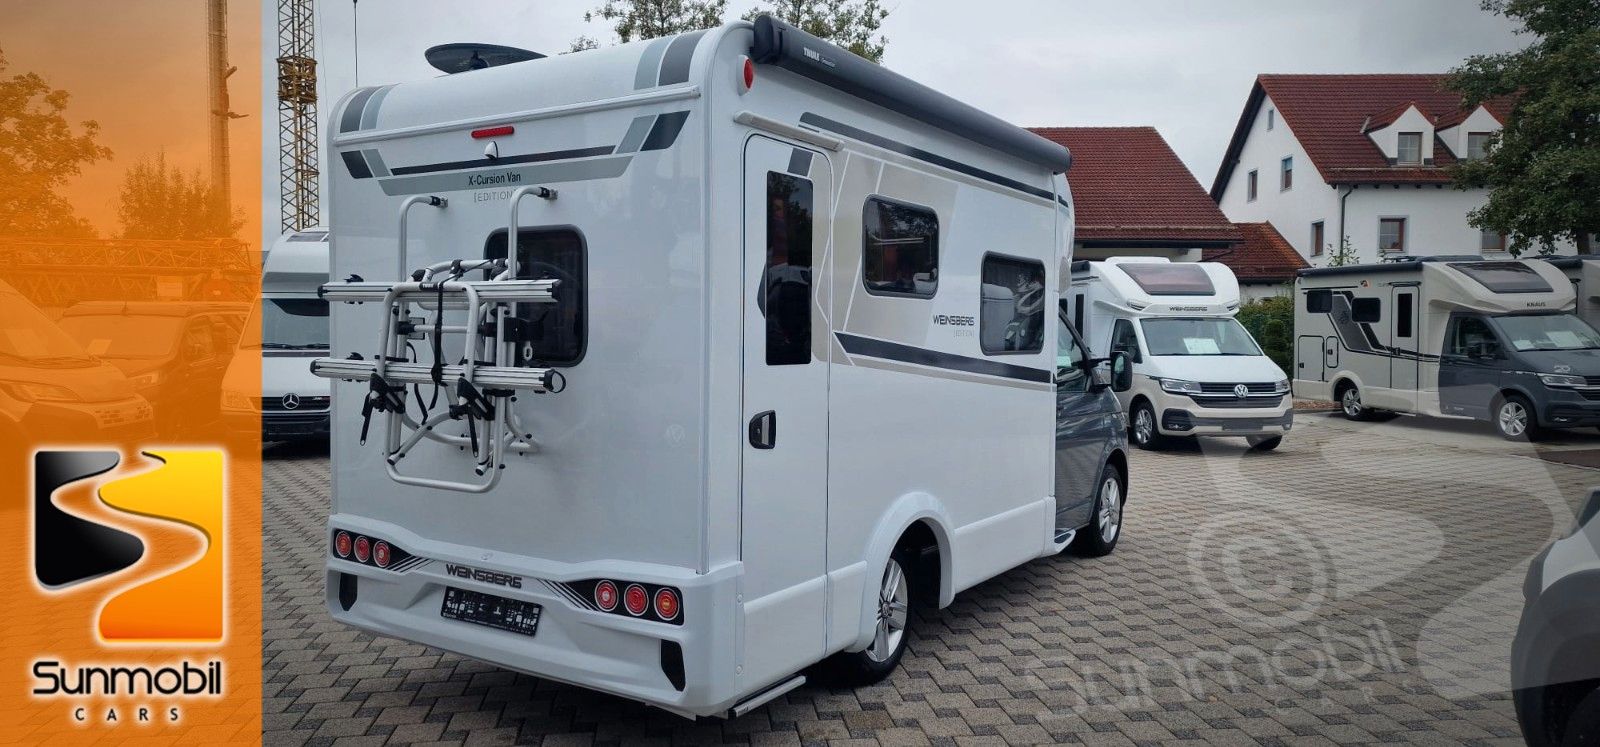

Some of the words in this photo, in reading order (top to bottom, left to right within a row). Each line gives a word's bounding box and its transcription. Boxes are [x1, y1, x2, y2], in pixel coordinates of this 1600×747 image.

[468, 174, 505, 186] X-Cursion
[506, 171, 521, 182] Van
[445, 563, 522, 589] WEINSBERG
